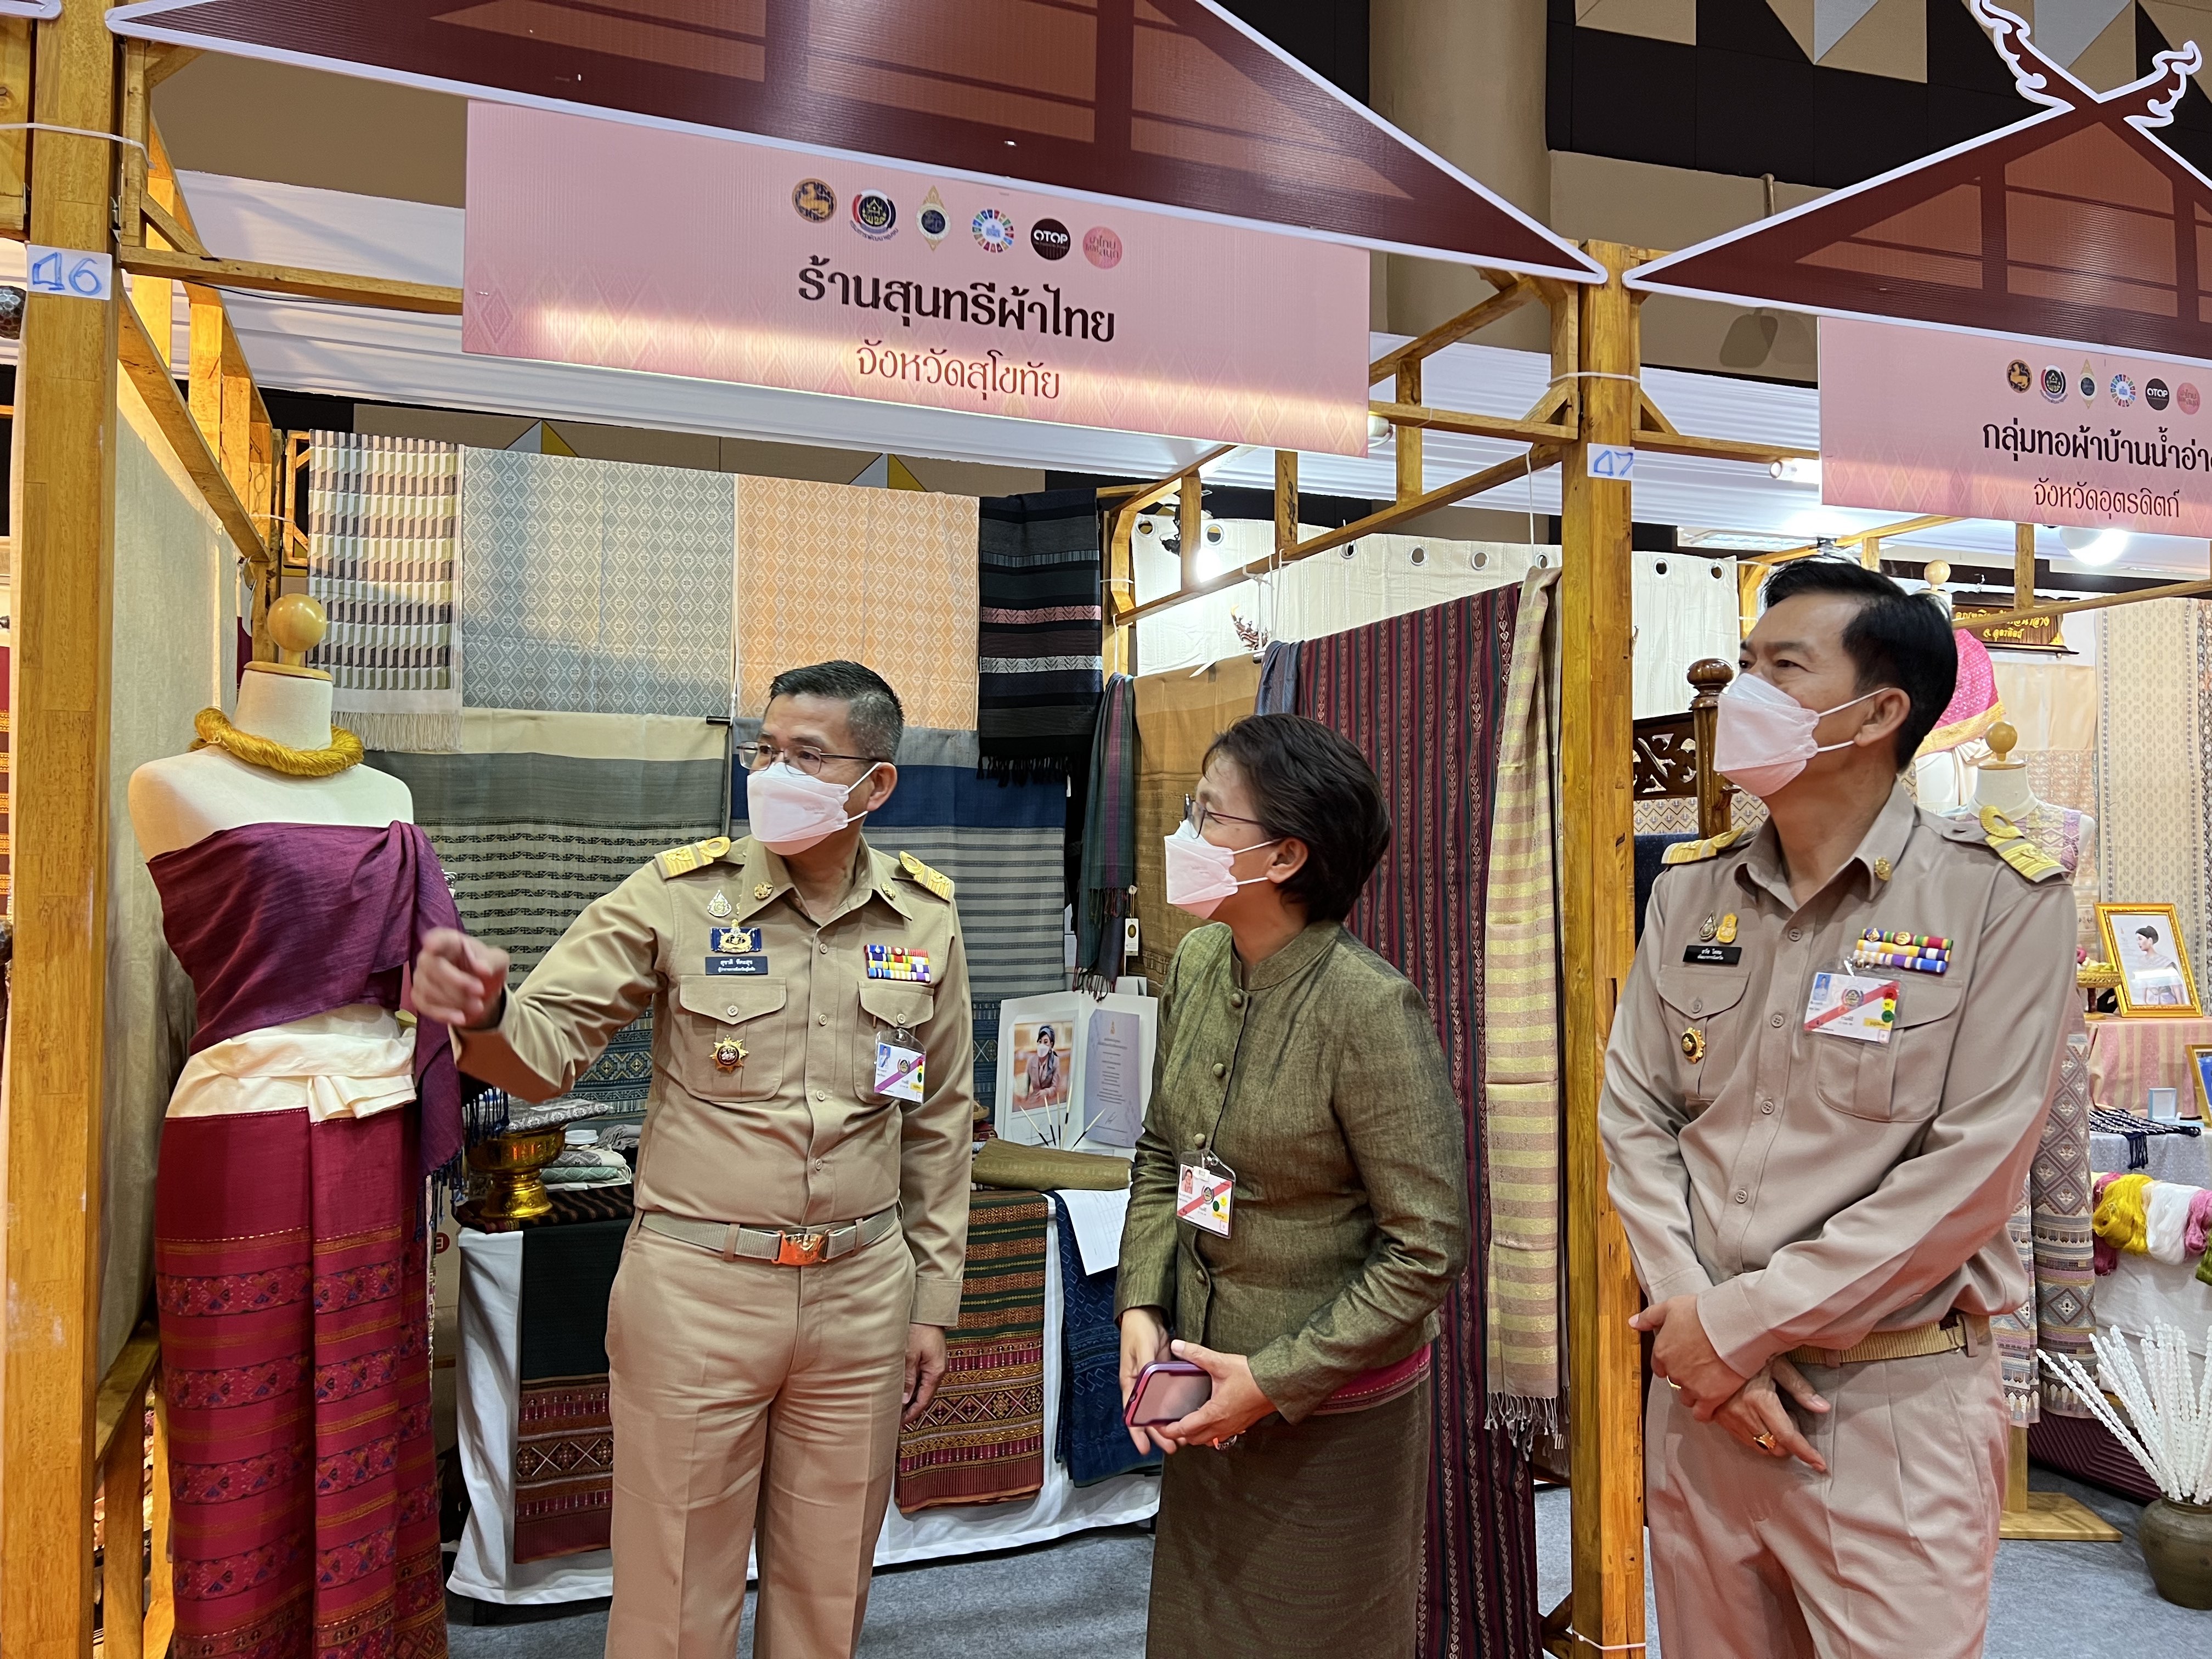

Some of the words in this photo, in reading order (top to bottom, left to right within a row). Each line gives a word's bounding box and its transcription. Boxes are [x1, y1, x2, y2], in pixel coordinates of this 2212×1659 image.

[1034, 229, 1068, 244] OTOP
[798, 255, 1115, 342] ร้านสุนทรีผ้าไทย
[856, 338, 1060, 400] จังหวัดสุโขทัย
[2147, 387, 2168, 398] OTOP
[1983, 417, 2212, 472] กลุ่มทอผ้าบ้านน้ำอ่า
[2033, 477, 2180, 519] จังหวัดอุตรดิตถ์
